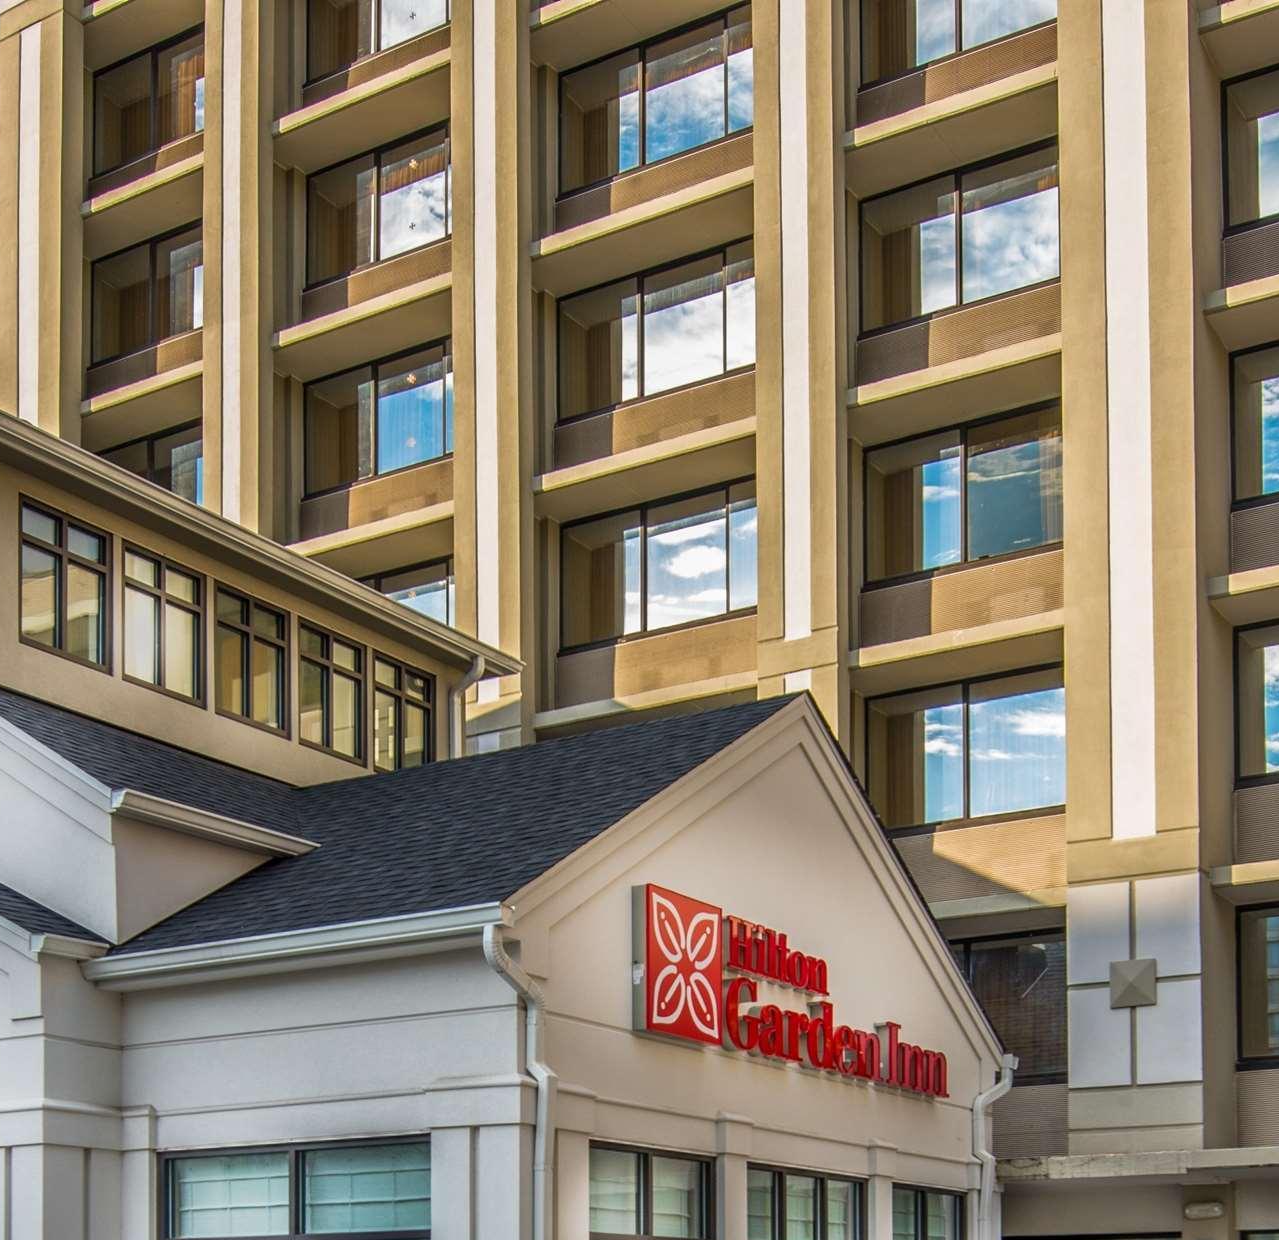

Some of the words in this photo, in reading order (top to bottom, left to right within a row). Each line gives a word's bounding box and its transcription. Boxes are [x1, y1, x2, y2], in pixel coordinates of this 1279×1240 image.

[725, 915, 830, 996] Hilton
[725, 977, 883, 1083] Garden
[886, 1021, 950, 1098] Inn
